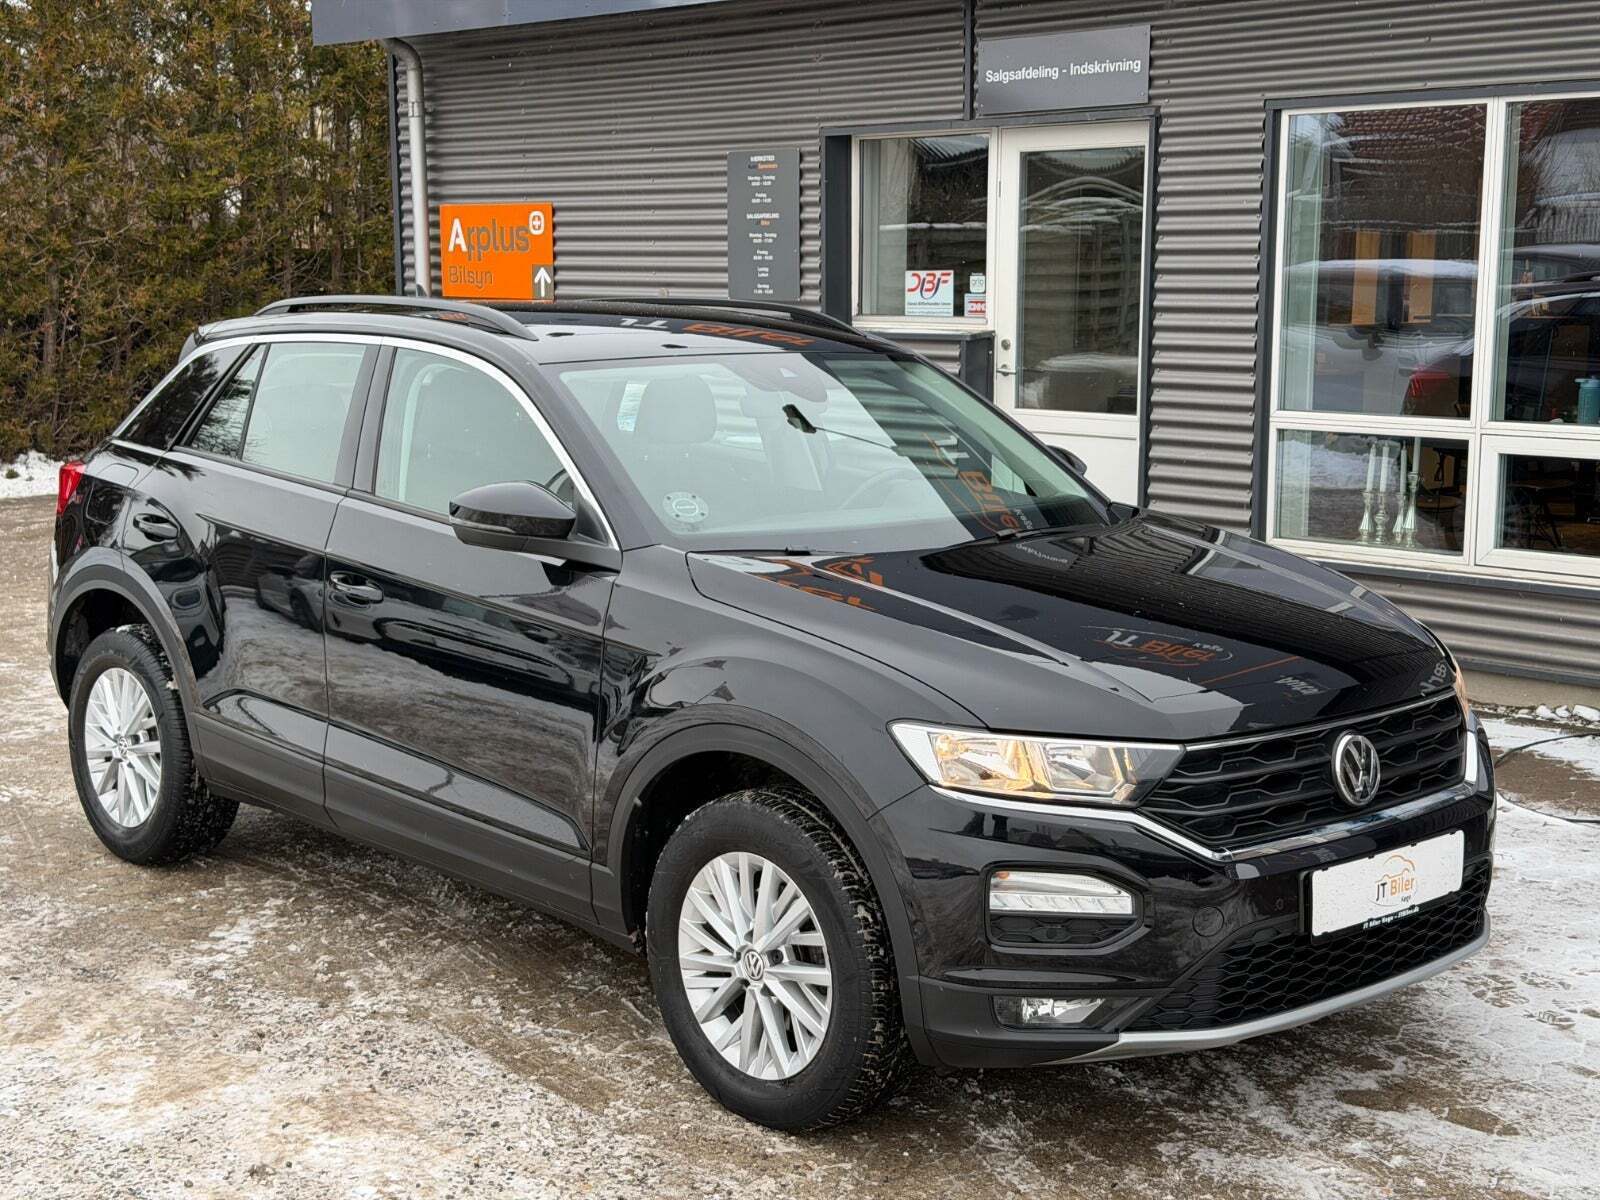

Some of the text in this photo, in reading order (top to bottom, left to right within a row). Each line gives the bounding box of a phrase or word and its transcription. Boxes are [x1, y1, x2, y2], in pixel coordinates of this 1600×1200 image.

[985, 65, 1059, 84] Salgsafdeling
[1070, 58, 1142, 76] Indskrivning
[448, 265, 493, 289] Bilsyn
[1389, 876, 1415, 897] Biler
